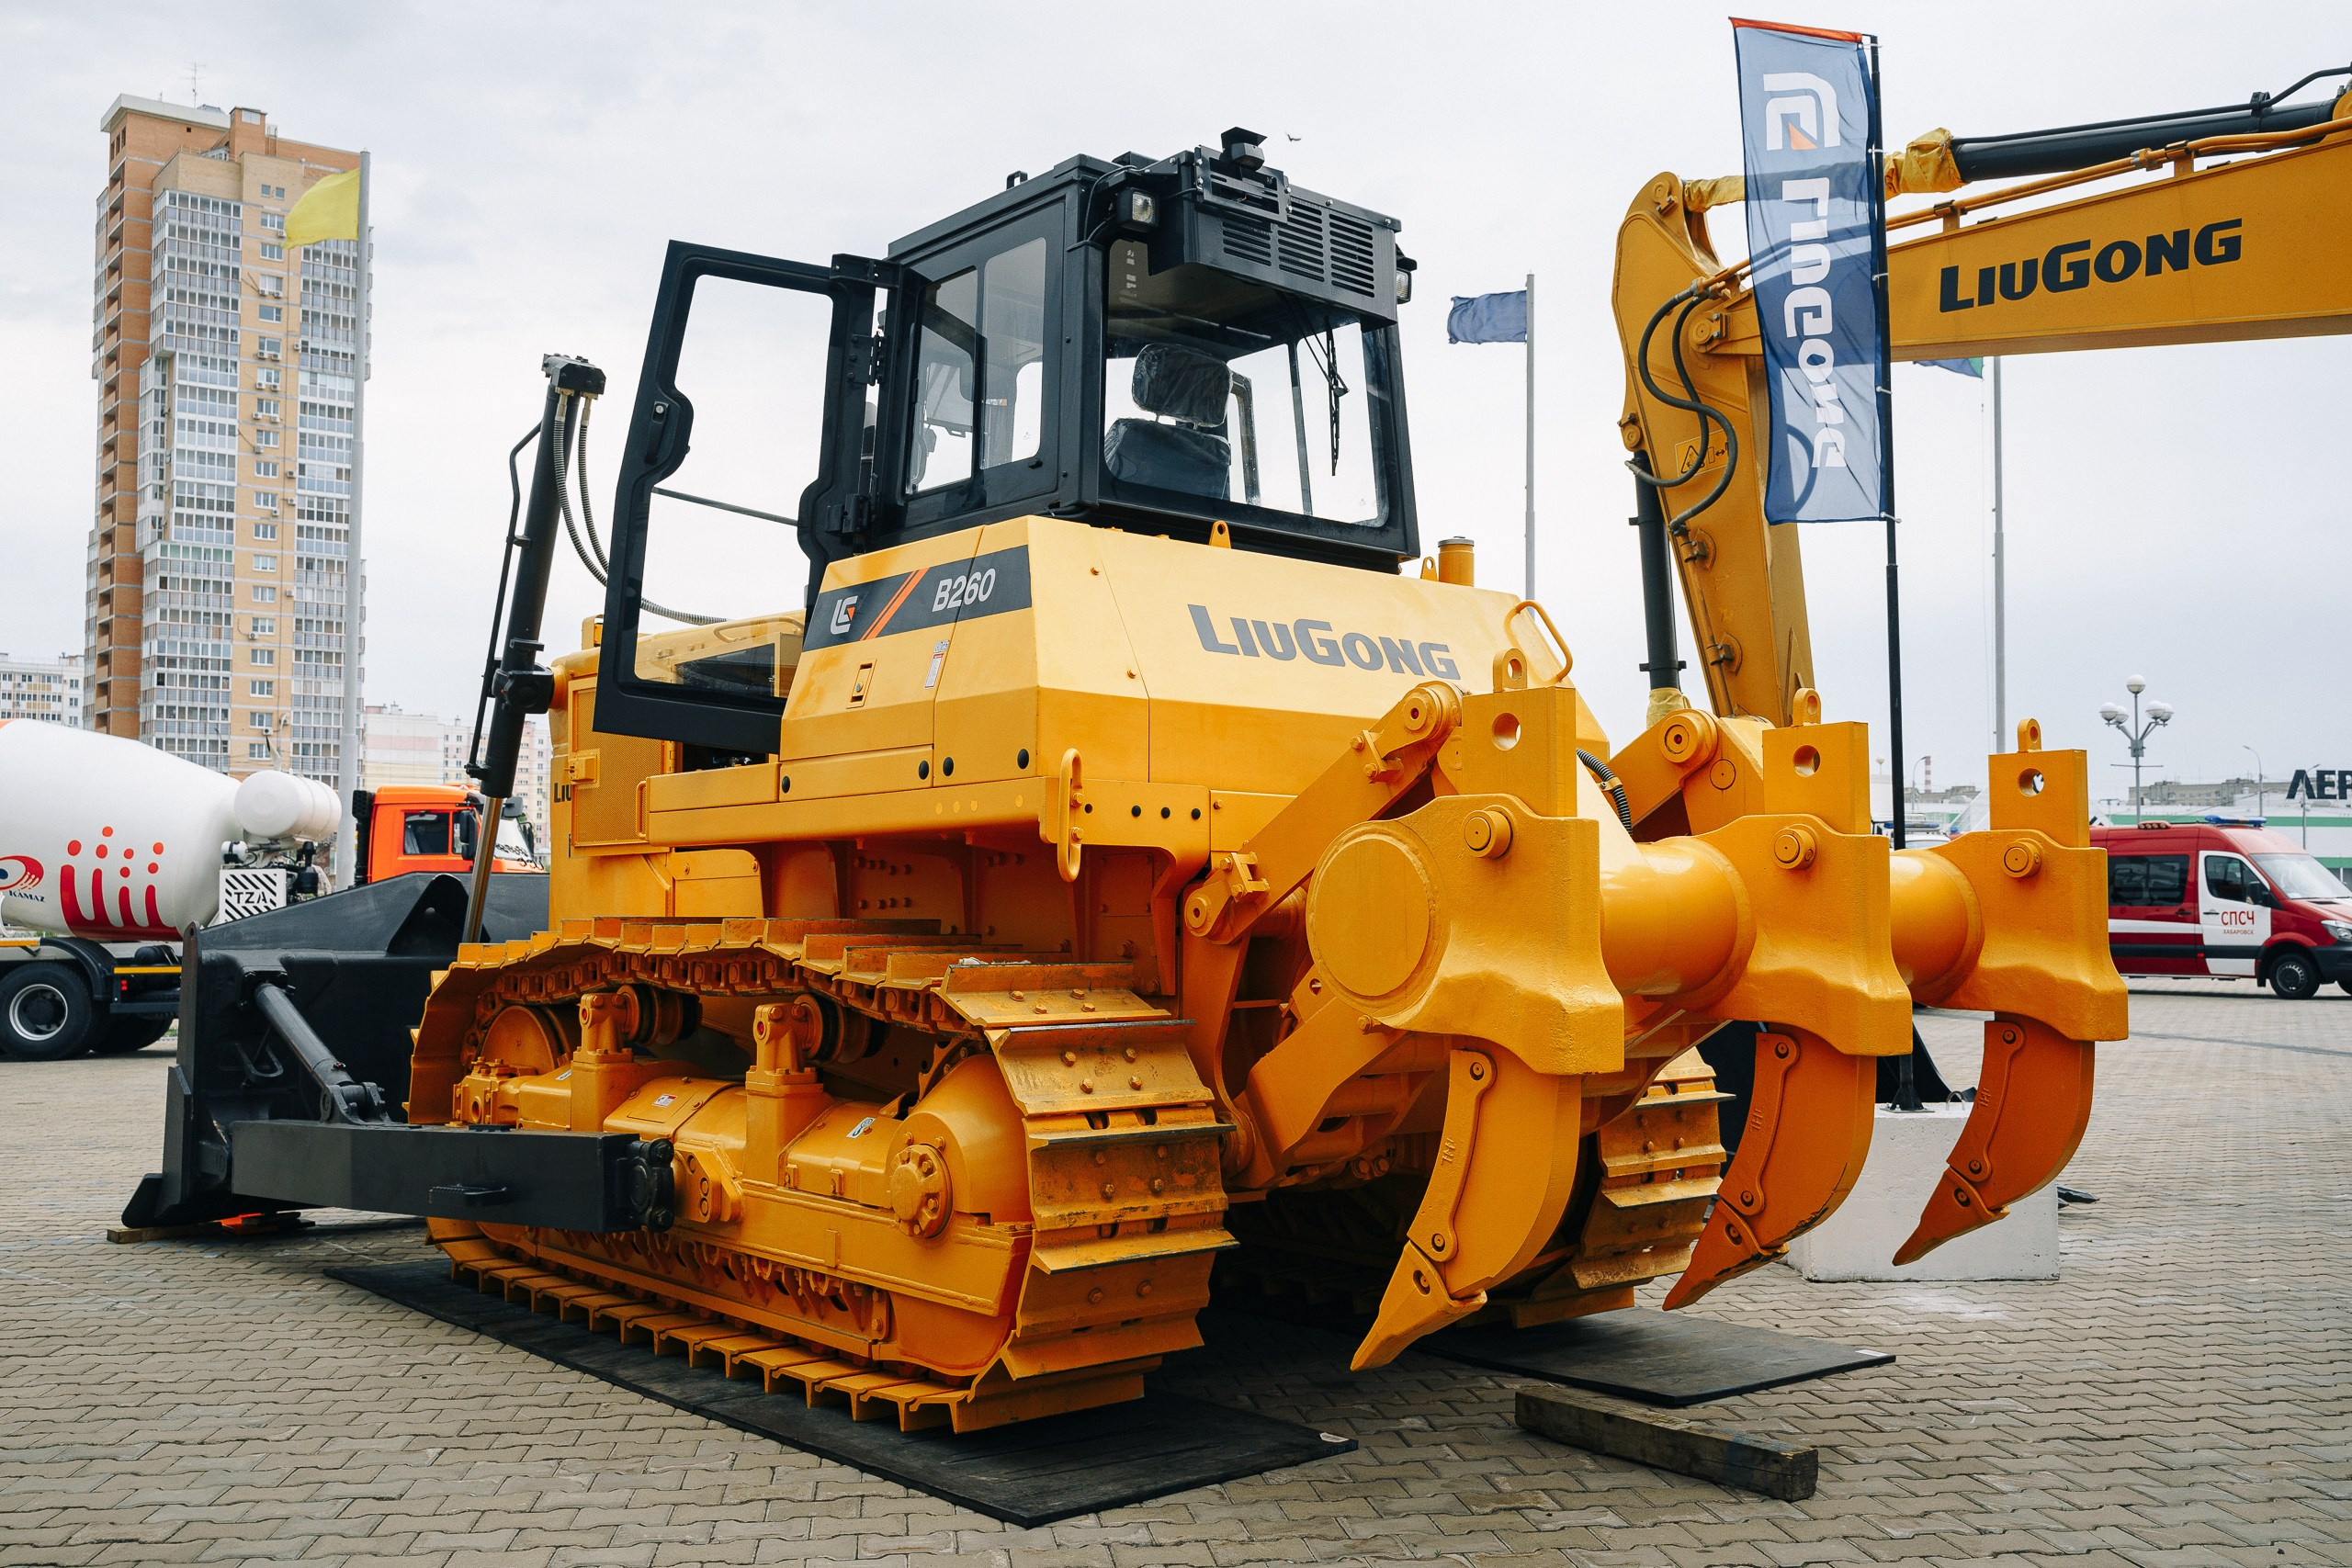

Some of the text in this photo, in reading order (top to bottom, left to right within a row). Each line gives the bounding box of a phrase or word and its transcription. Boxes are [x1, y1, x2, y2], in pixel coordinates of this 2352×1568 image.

[932, 568, 996, 613] B260
[9, 890, 45, 903] KAMAZ
[234, 891, 267, 904] TZA
[2221, 910, 2255, 926] СПСЧ
